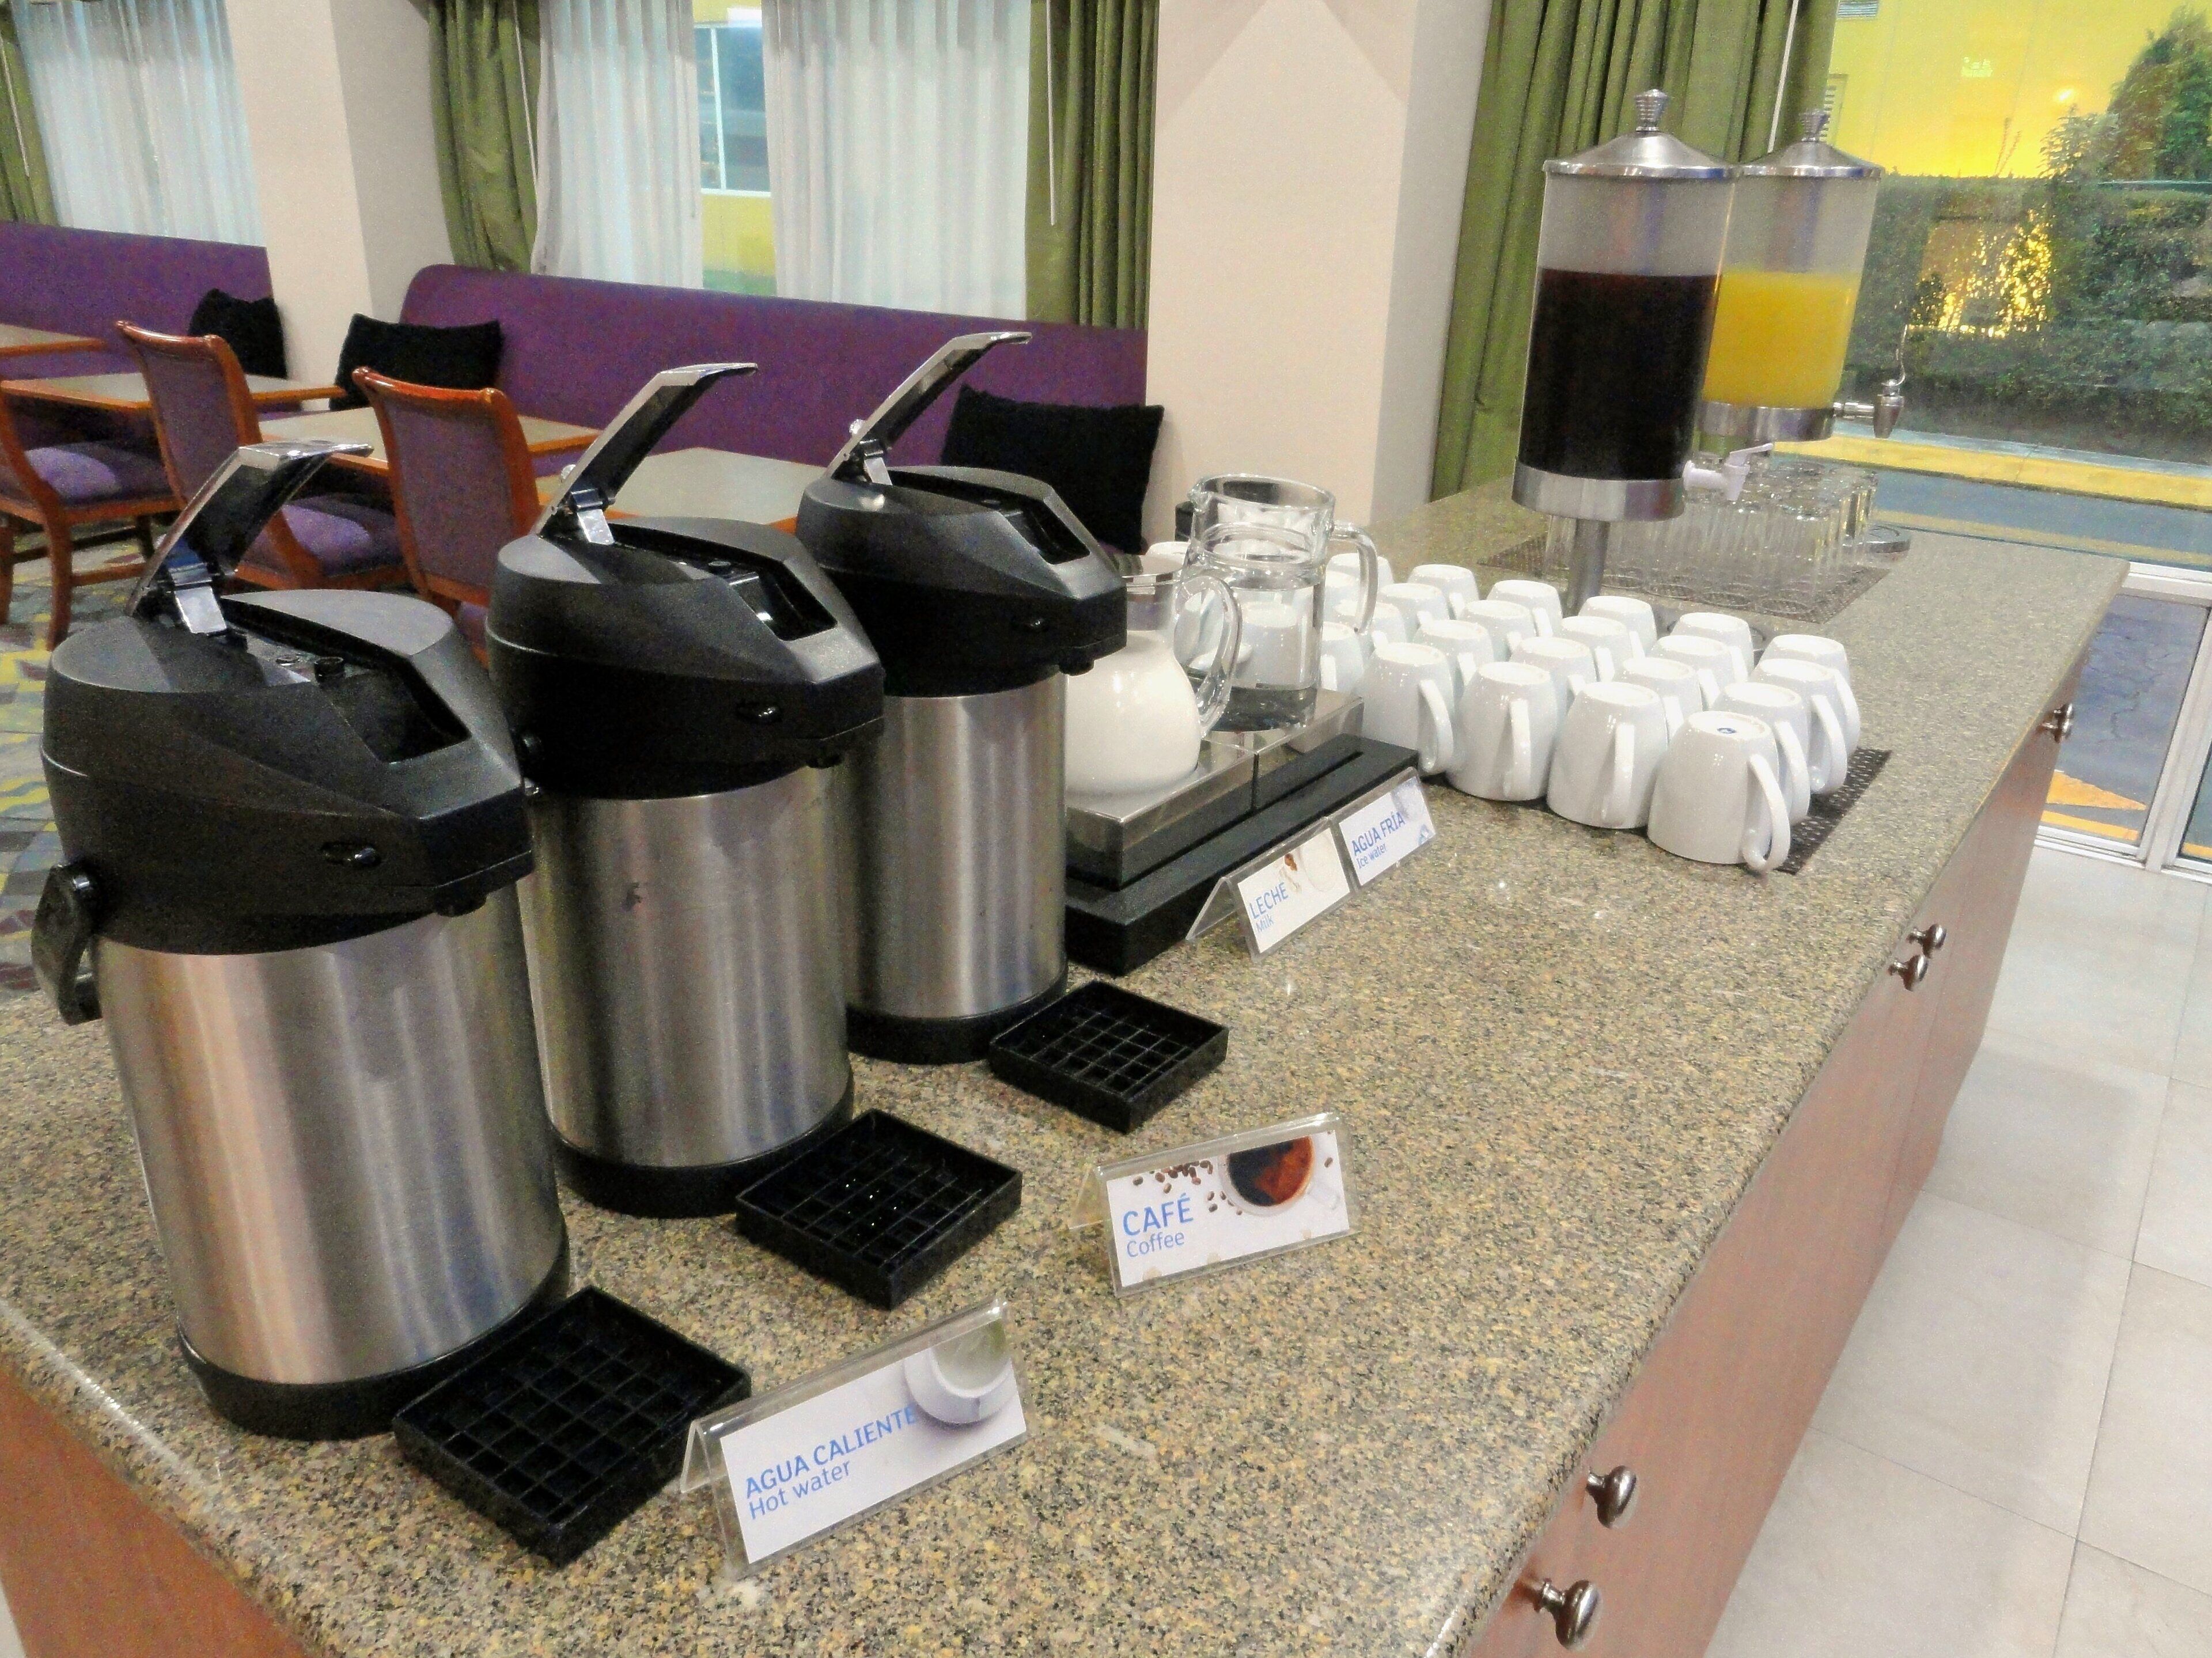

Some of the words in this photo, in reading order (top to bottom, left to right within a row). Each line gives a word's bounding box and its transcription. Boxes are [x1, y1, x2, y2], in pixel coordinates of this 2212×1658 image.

[1351, 827, 1381, 855] AGUA
[1380, 811, 1406, 837] FRÍA
[1356, 855, 1368, 870] Ice
[1369, 843, 1387, 862] water
[1249, 882, 1289, 919] LECHE
[1255, 915, 1274, 933] Milk
[1123, 1193, 1194, 1236] CAFÉ
[1126, 1231, 1185, 1258] Coffee
[746, 1456, 809, 1499] AGUA
[813, 1405, 917, 1465] CALIENTE
[749, 1488, 787, 1520] Hot
[793, 1459, 851, 1498] water
